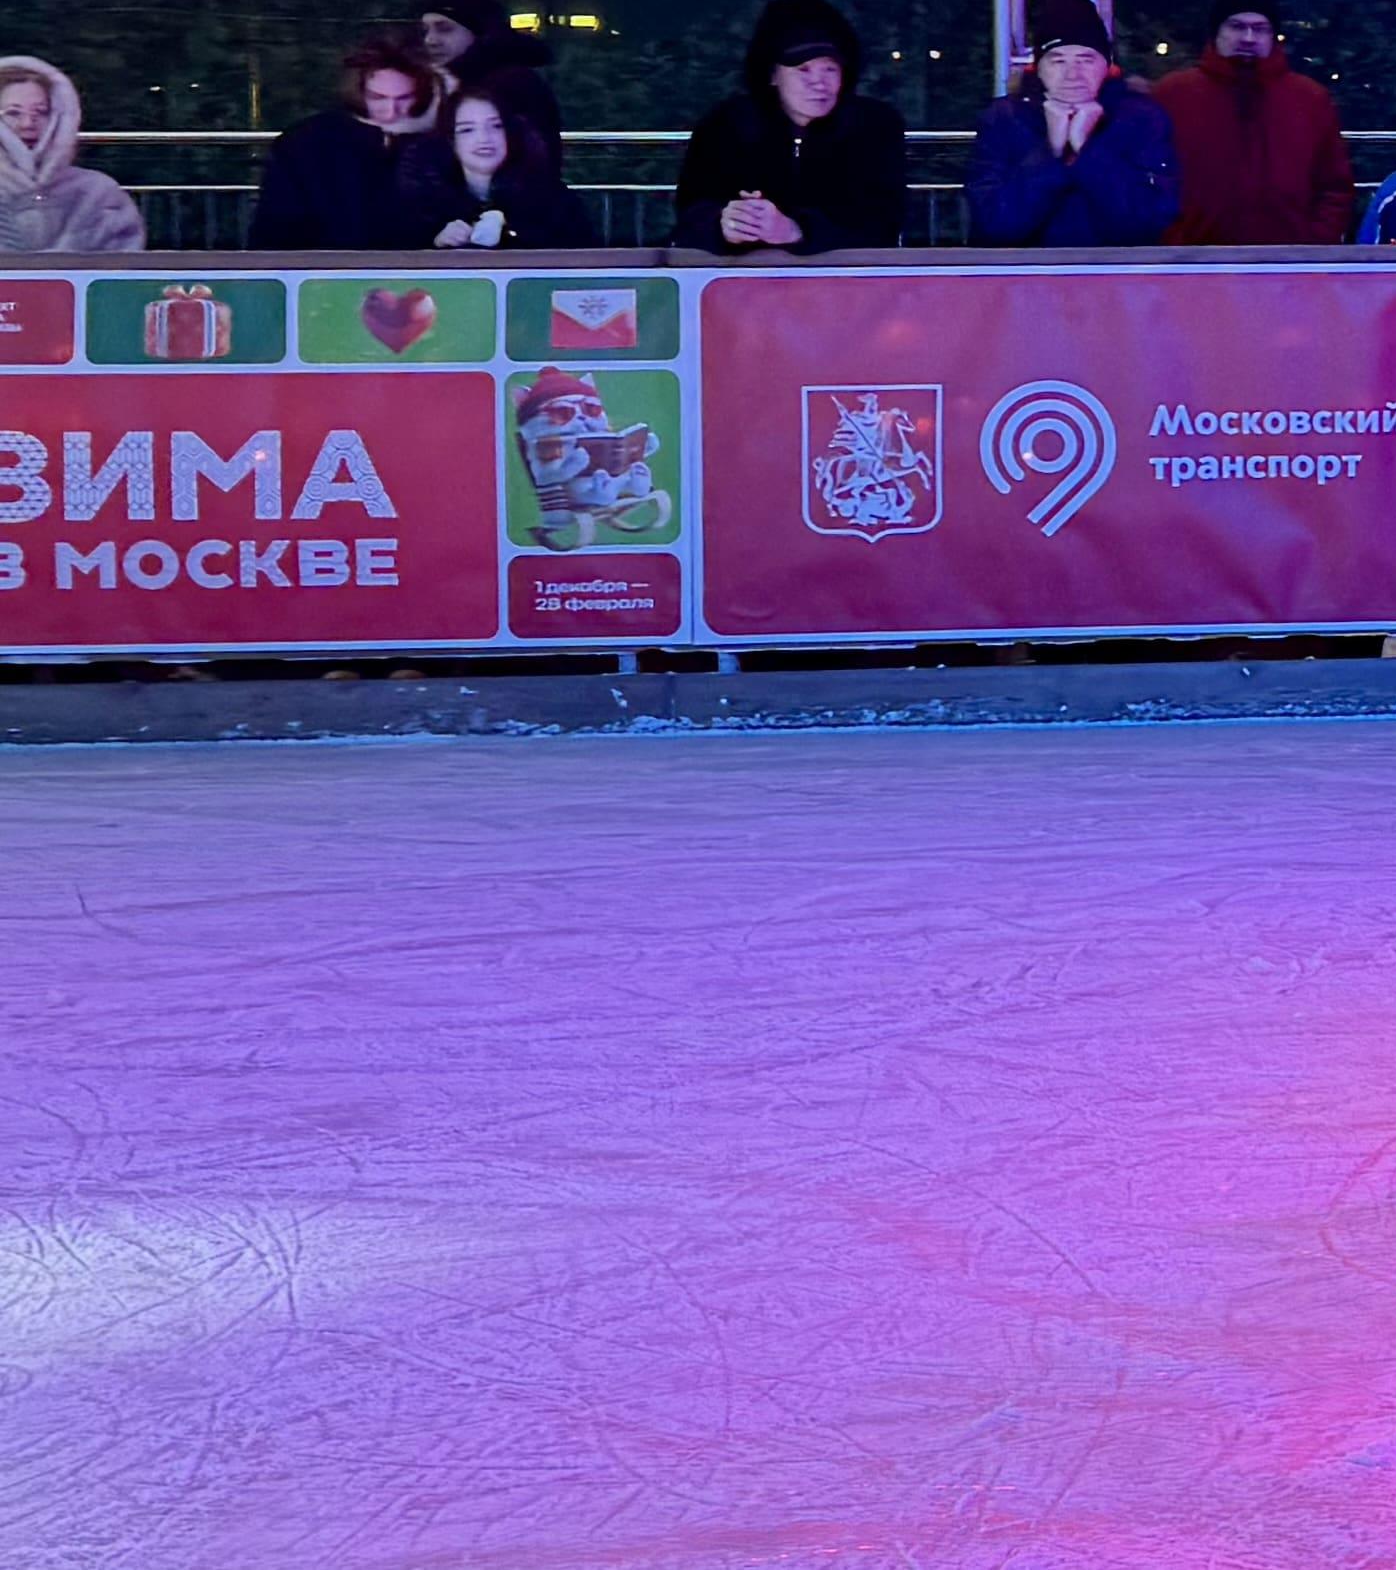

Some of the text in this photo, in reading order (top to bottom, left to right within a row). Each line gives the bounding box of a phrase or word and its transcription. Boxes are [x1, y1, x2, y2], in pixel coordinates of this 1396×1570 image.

[0, 430, 398, 524] ЗИМА
[1149, 455, 1362, 487] транспорт
[55, 538, 399, 591] МОСКВЕ
[534, 580, 544, 593] 1
[545, 579, 628, 595] декабря
[535, 597, 655, 612] 28 февраля
